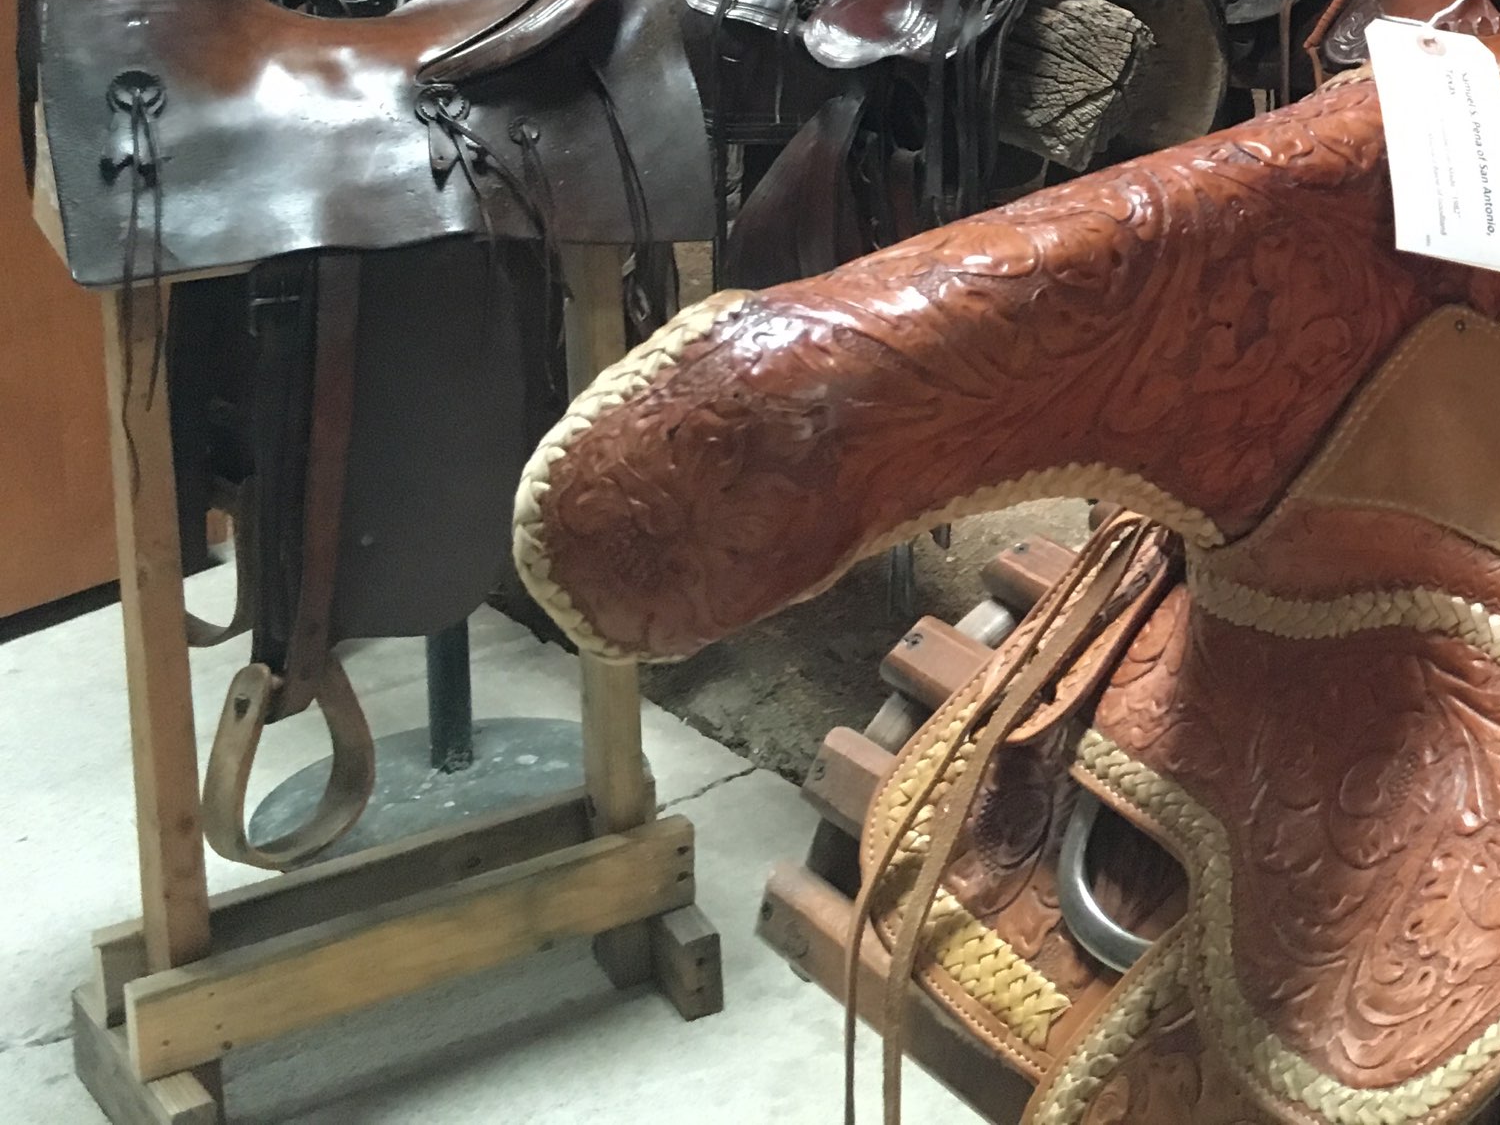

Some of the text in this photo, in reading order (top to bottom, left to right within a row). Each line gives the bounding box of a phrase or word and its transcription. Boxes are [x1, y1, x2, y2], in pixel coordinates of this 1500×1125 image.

[1477, 149, 1487, 161] of
[1479, 164, 1489, 184] San
[1483, 186, 1496, 236] Antonio,
